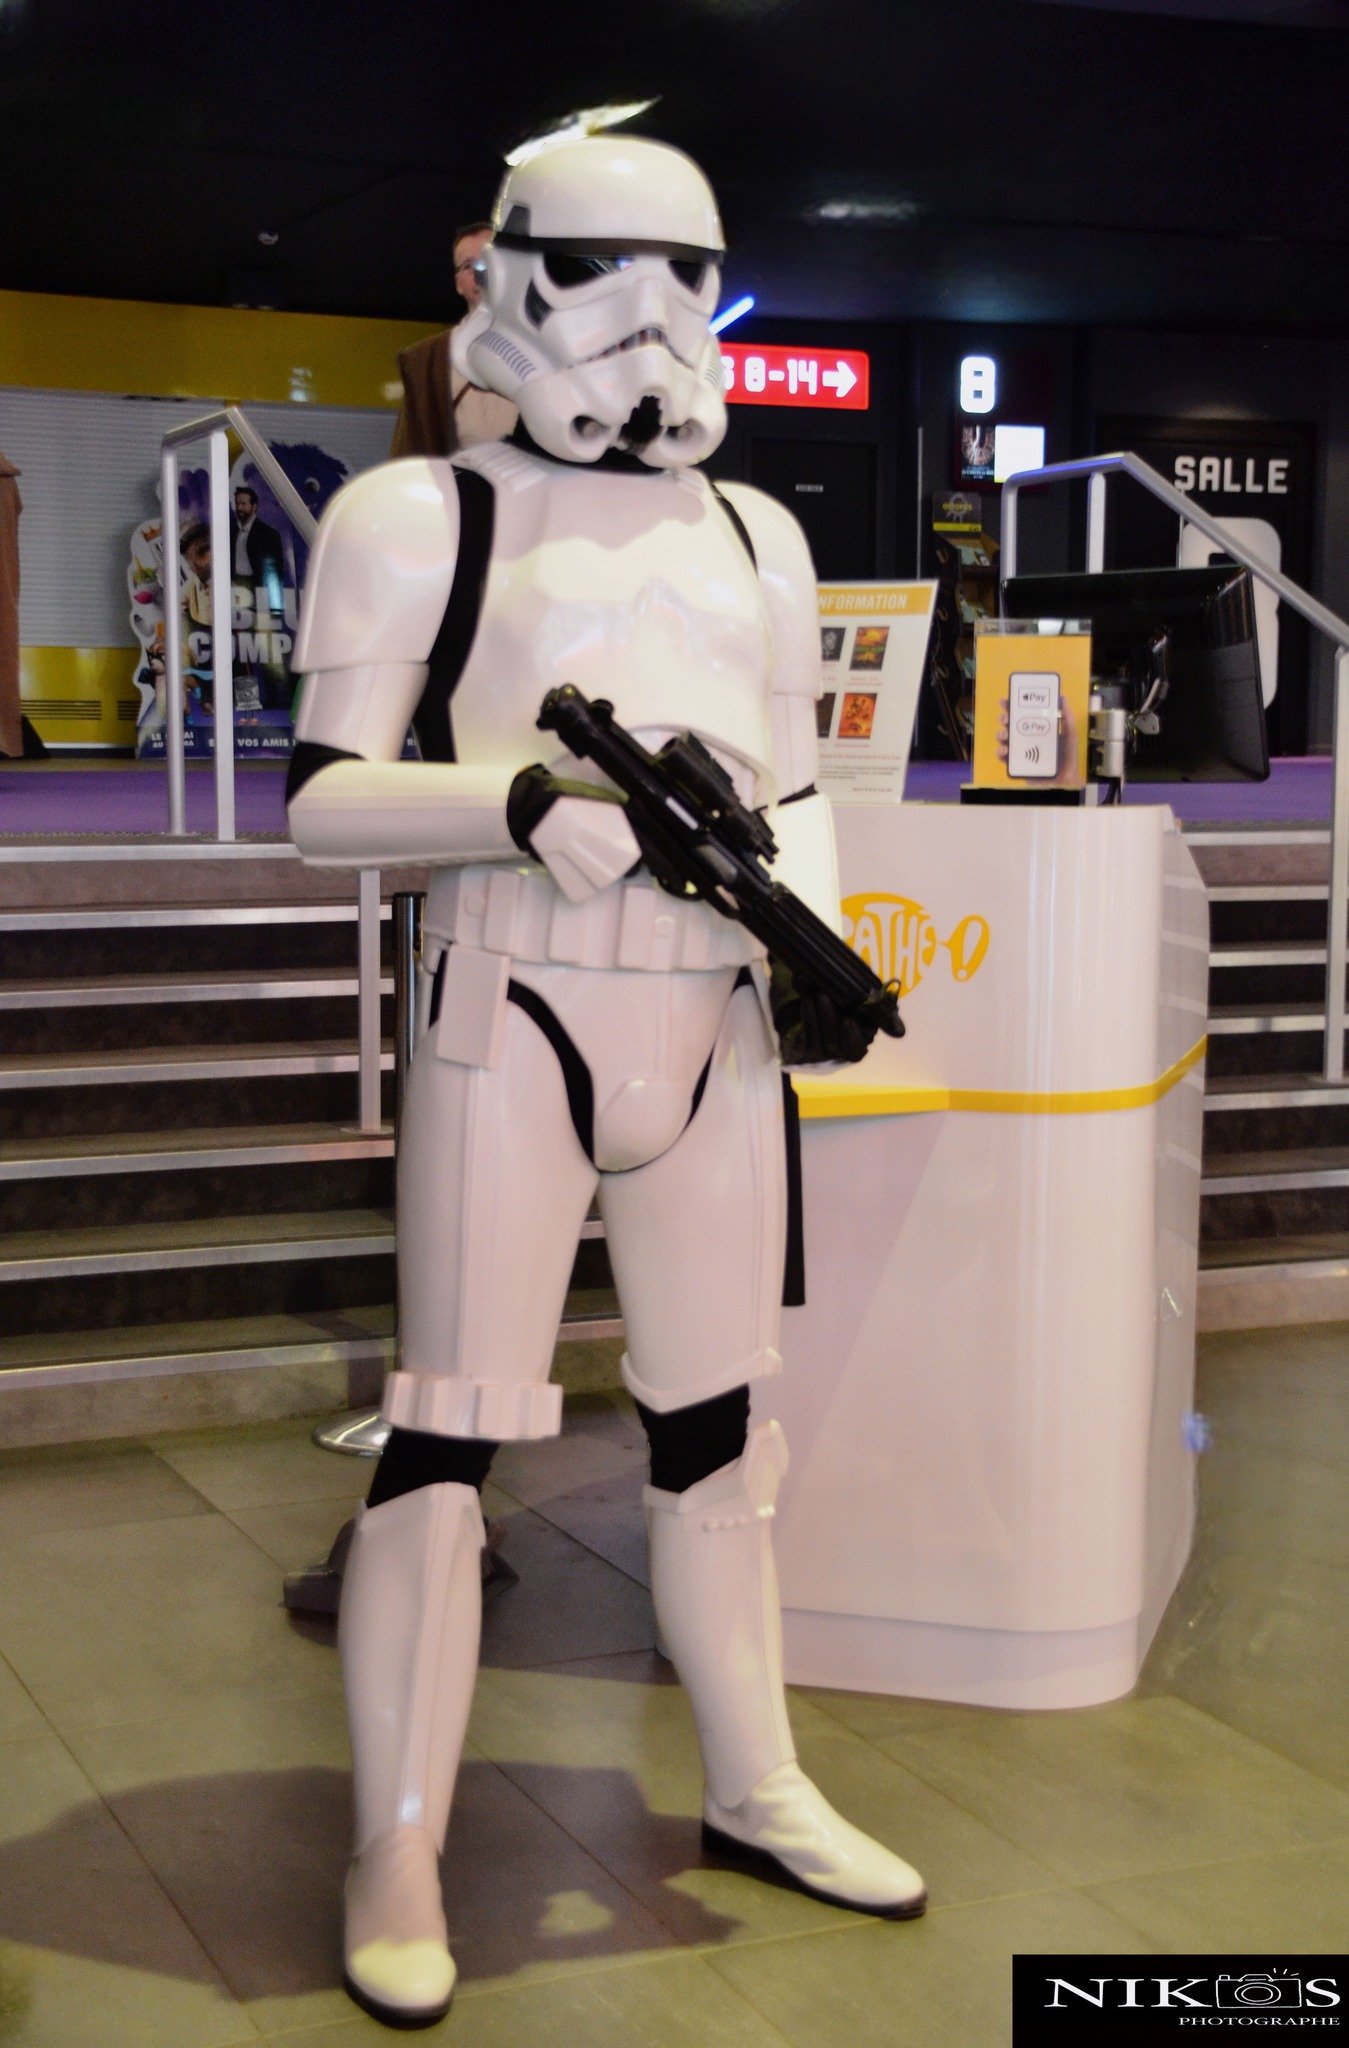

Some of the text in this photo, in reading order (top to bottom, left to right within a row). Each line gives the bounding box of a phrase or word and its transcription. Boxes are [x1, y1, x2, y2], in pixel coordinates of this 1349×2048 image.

[745, 356, 817, 395] 8-14
[961, 356, 995, 413] 8
[1174, 456, 1289, 494] SALLE
[230, 586, 303, 630] BLU
[819, 593, 908, 610] NFORMATION
[188, 631, 292, 663] CMP
[237, 738, 259, 747] VOS
[262, 738, 289, 747] AMIS
